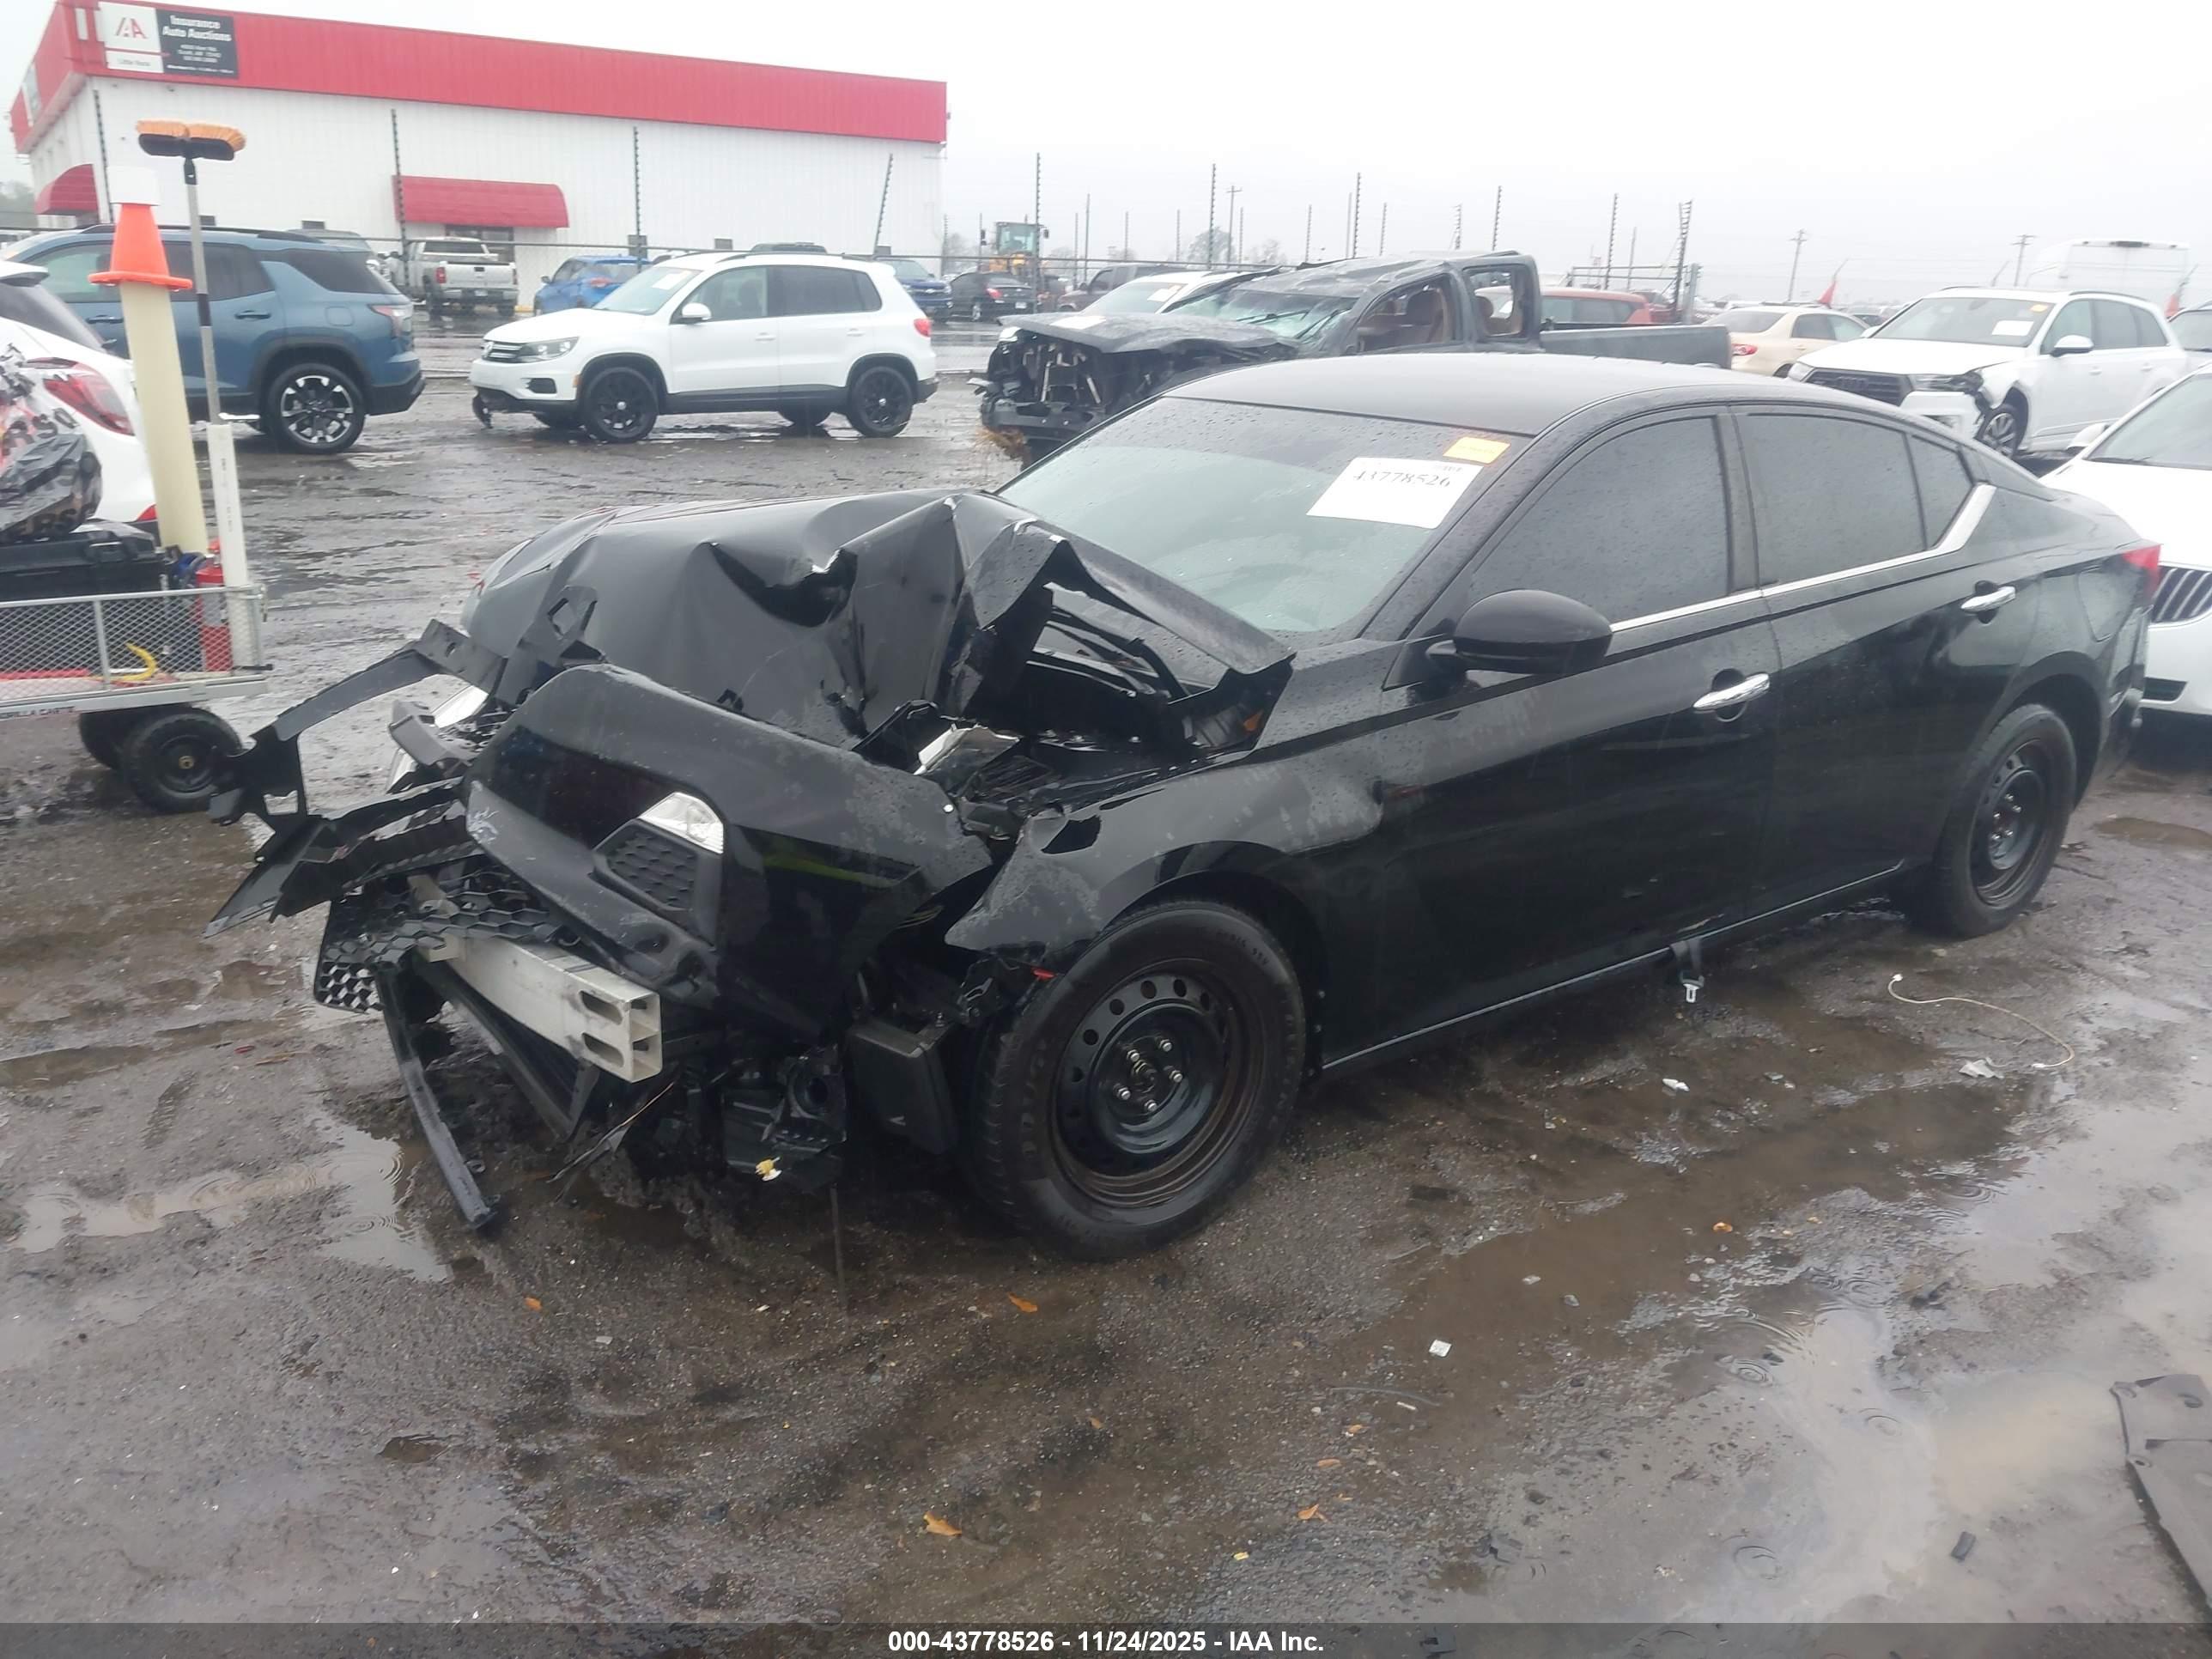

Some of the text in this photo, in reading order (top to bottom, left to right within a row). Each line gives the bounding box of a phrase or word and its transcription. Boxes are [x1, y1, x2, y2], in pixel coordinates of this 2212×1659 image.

[170, 14, 221, 29] Insurance
[162, 26, 232, 42] Auto Auctions
